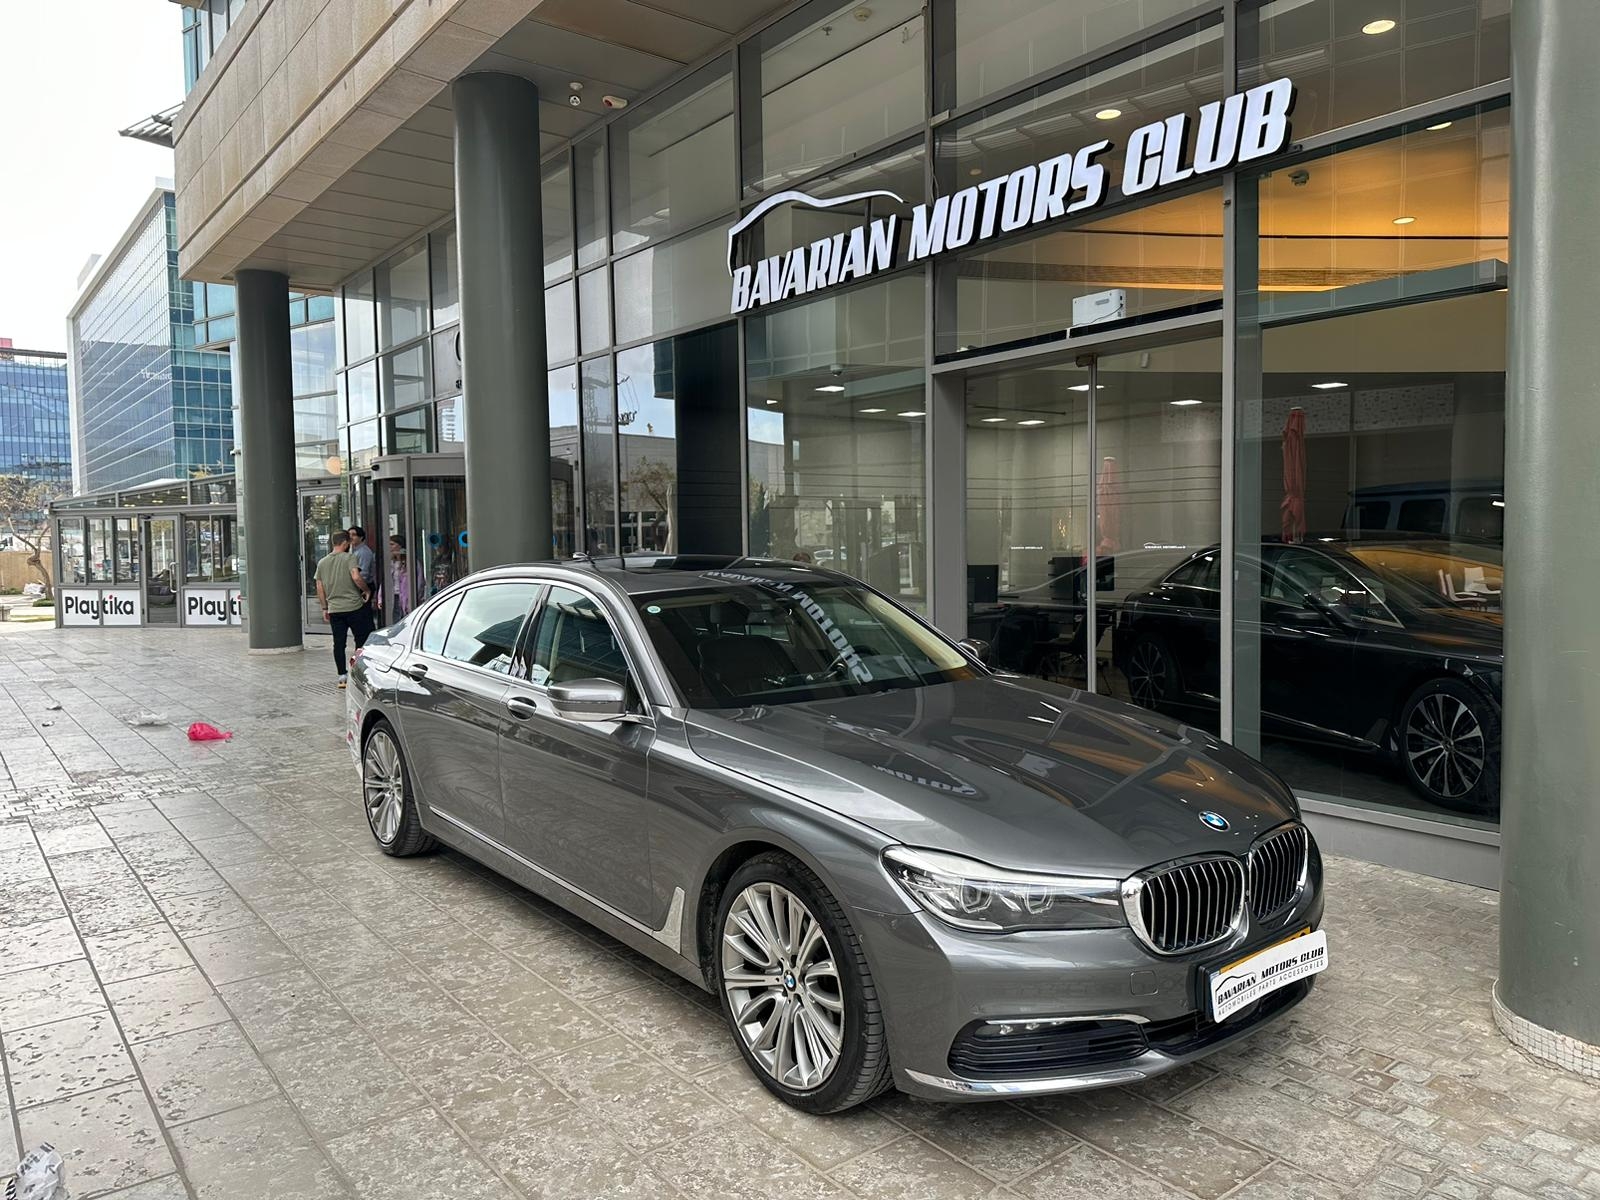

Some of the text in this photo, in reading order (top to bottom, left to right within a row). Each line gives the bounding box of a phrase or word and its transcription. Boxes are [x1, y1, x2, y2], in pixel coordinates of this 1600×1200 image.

[731, 77, 1295, 314] BAVARIAN MOTORS CLUB
[65, 595, 134, 620] Playtika
[188, 595, 242, 621] Playti
[1217, 947, 1324, 1005] BAVARIAN MOTORS CLUB
[1218, 959, 1324, 1015] AUTOMOBILES PARTS ACCESSORIES
